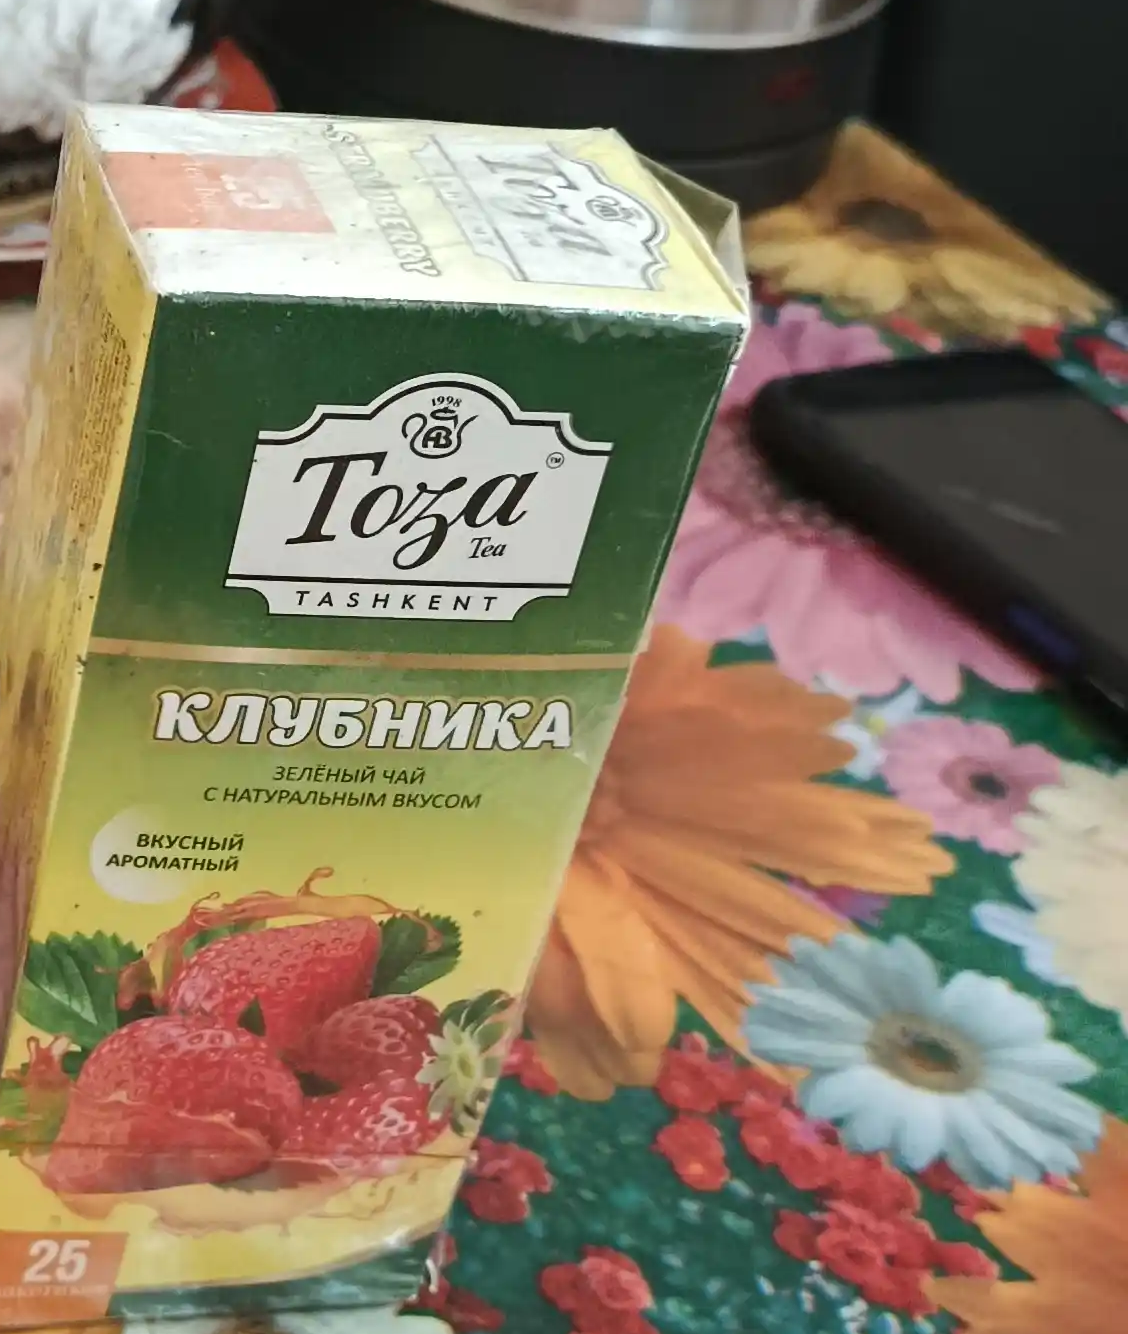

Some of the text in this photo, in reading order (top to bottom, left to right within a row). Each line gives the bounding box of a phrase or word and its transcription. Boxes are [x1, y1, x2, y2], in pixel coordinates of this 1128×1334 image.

[431, 395, 462, 408] 1998
[284, 450, 539, 570] Toza
[468, 536, 508, 559] Tea
[295, 590, 498, 612] TASHKENT
[152, 691, 573, 751] КЛУБНИКА
[272, 764, 426, 785] ЗЕЛЁНЫЙ ЧАЙ
[203, 786, 482, 809] С НАТУРАЛЬНЫМ ВКУСОМ
[136, 832, 245, 852] ВКУСНЫЙ
[105, 853, 239, 872] АРОМАТНЫЙ
[24, 1238, 91, 1284] 25
